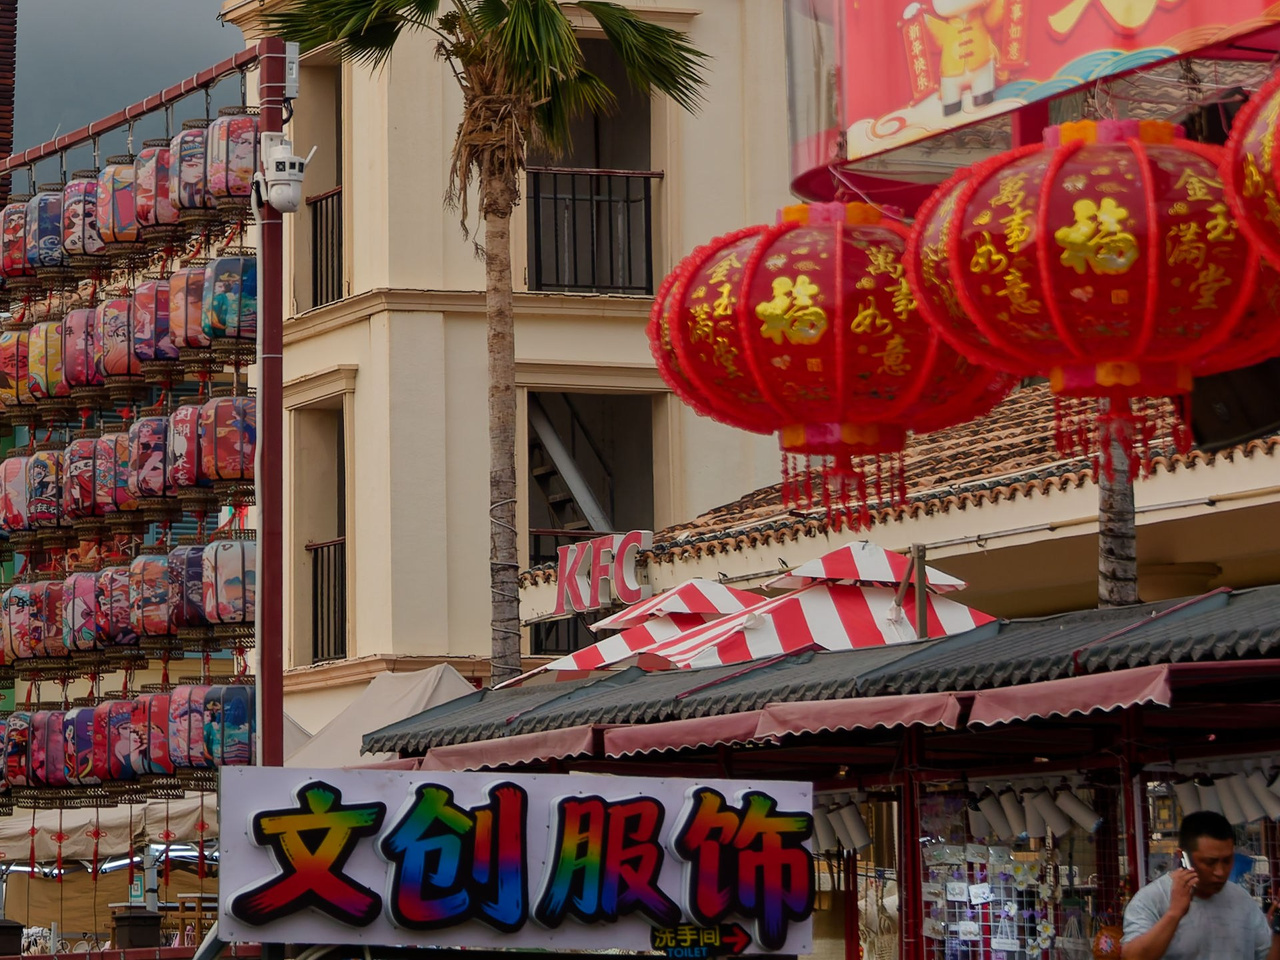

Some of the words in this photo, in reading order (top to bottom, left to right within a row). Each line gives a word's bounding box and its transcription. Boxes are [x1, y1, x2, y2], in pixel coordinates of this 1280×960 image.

[1055, 196, 1140, 275] 福
[755, 275, 828, 345] 福
[552, 530, 652, 617] KFC
[225, 780, 815, 950] 文创服饰
[654, 926, 720, 947] 洗手间
[667, 947, 708, 958] TOILET
